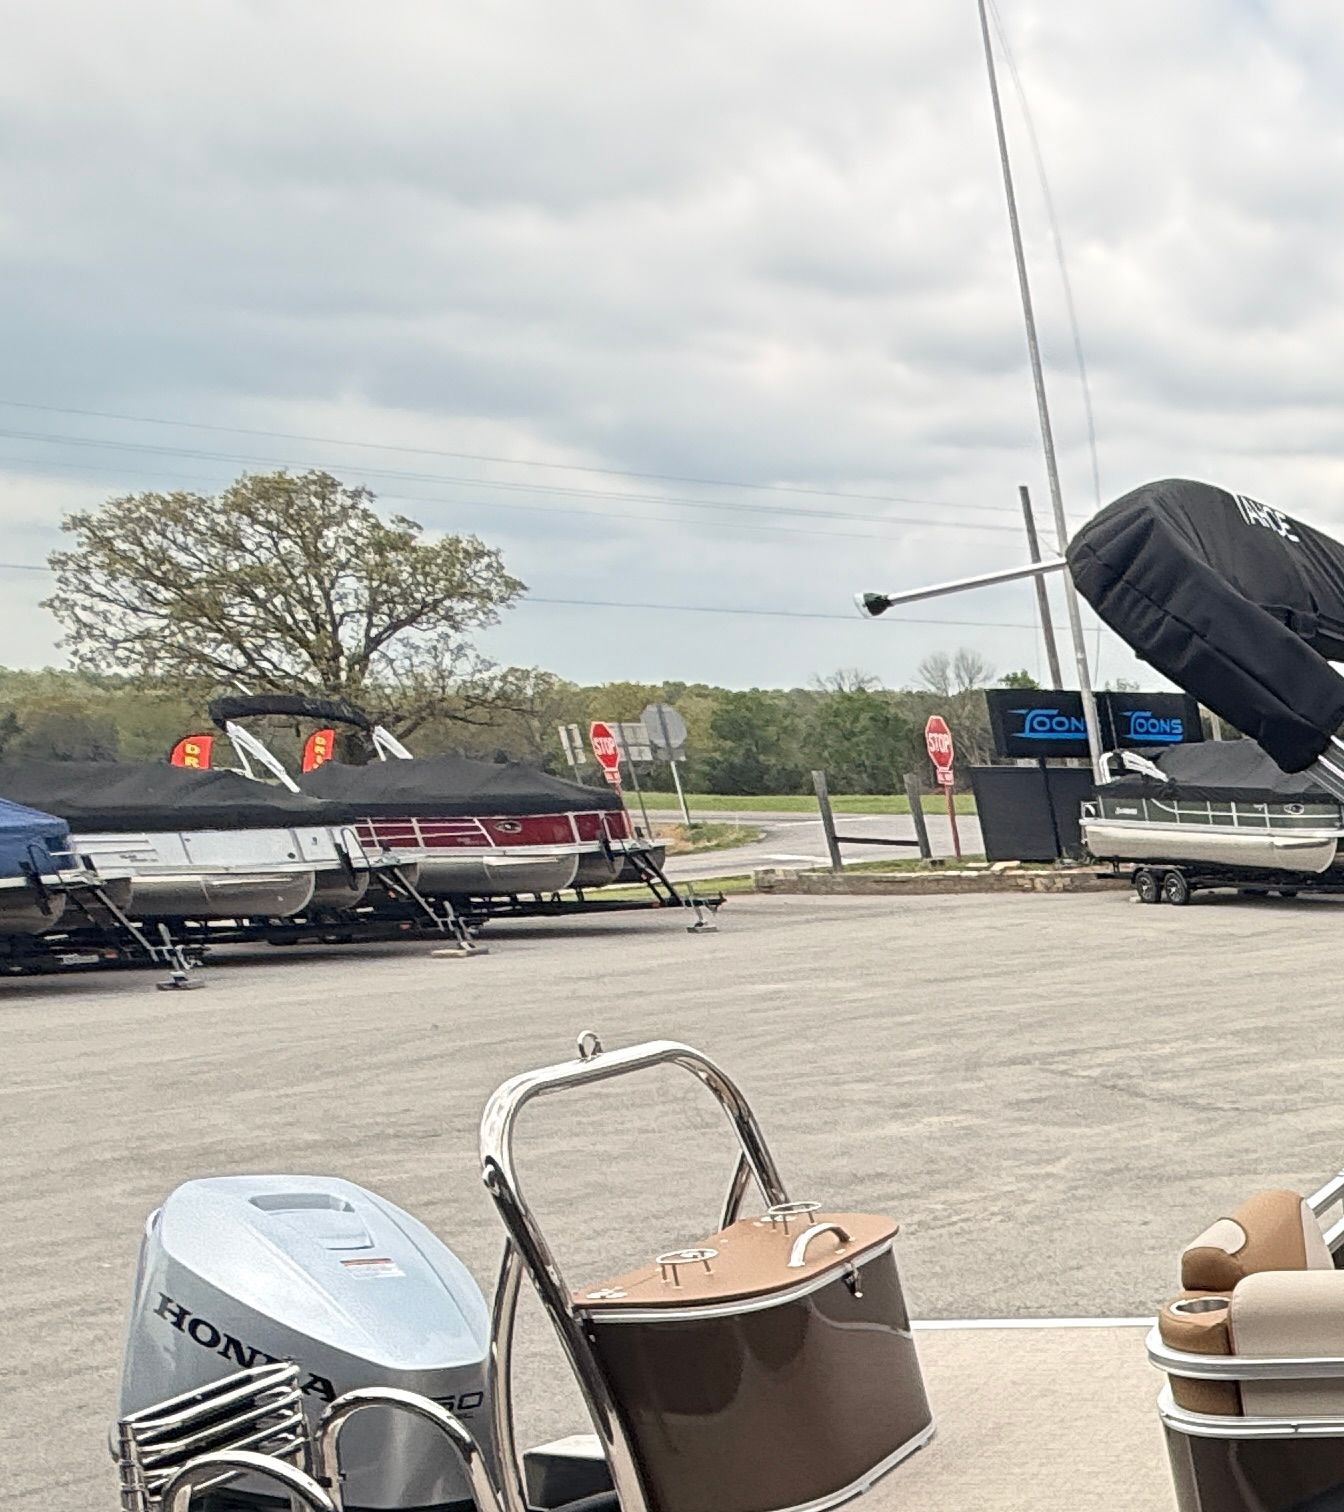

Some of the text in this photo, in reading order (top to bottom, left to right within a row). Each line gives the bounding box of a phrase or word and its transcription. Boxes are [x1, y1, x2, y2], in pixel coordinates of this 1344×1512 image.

[1007, 708, 1088, 740] TOON
[1120, 710, 1184, 742] TOONS
[592, 736, 618, 756] STOP
[928, 732, 950, 753] STOP
[153, 1292, 338, 1404] HONA
